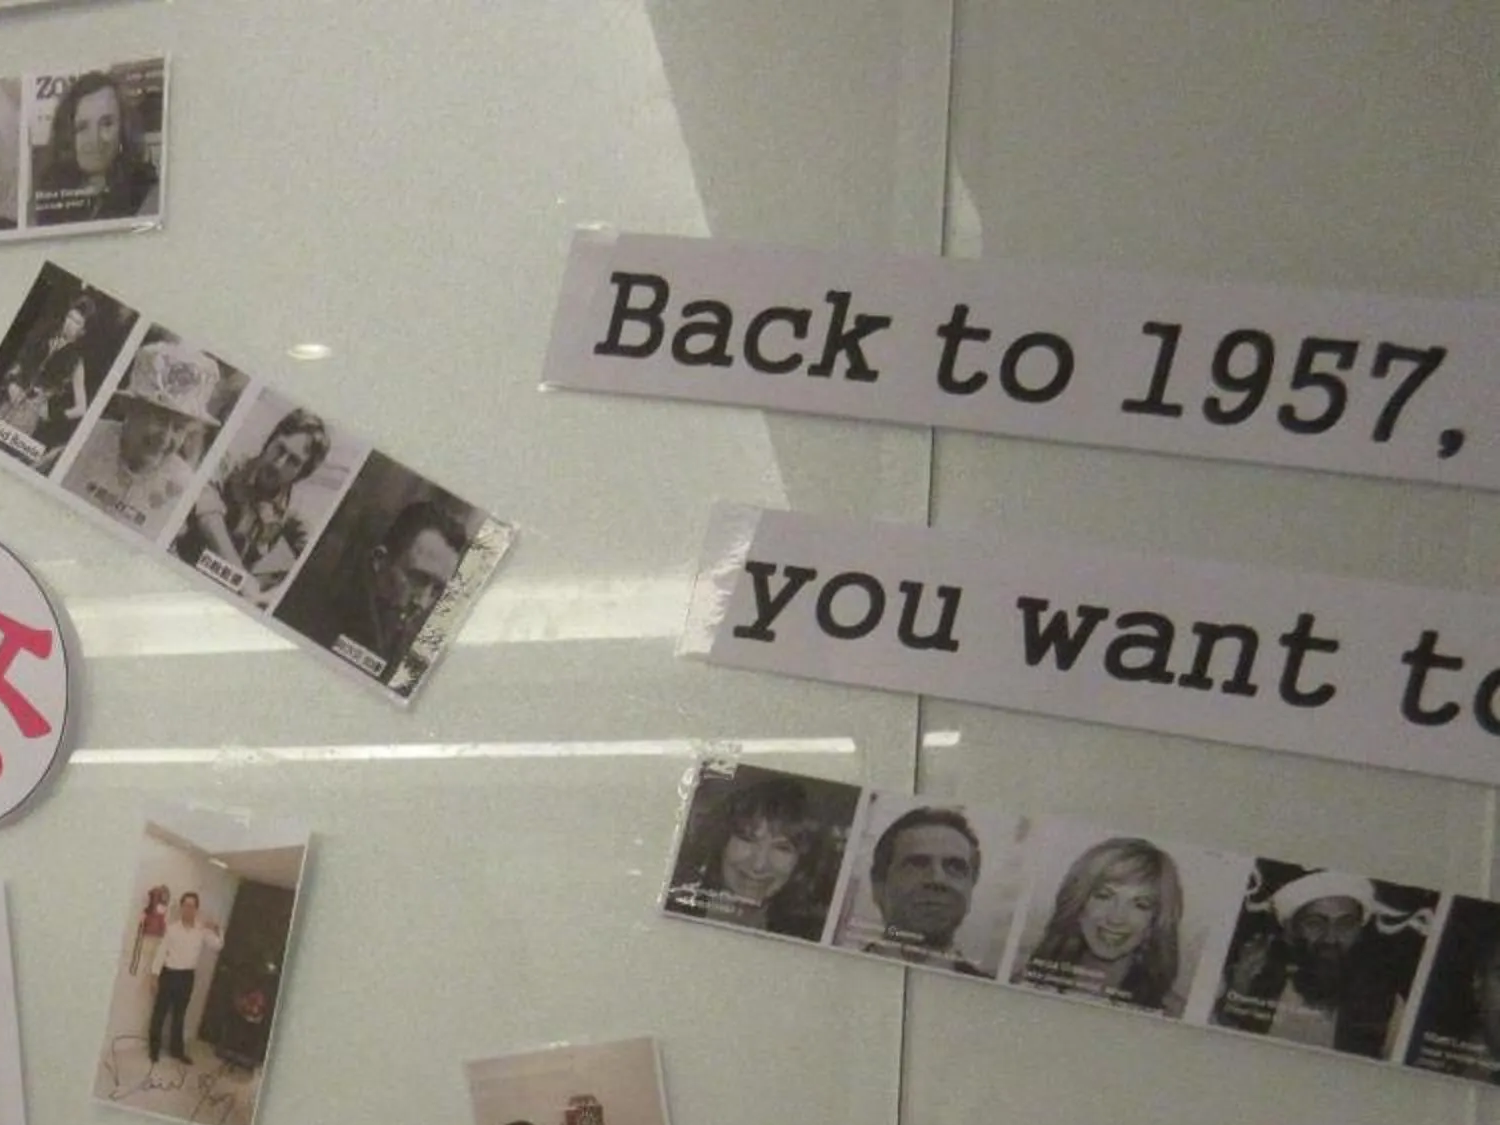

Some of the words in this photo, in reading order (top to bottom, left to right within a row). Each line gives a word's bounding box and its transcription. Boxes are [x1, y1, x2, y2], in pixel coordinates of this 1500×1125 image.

[595, 272, 891, 382] Back
[937, 304, 1074, 403] to
[1122, 322, 1465, 459] 1957,
[734, 562, 961, 652] you
[1017, 597, 1339, 707] want
